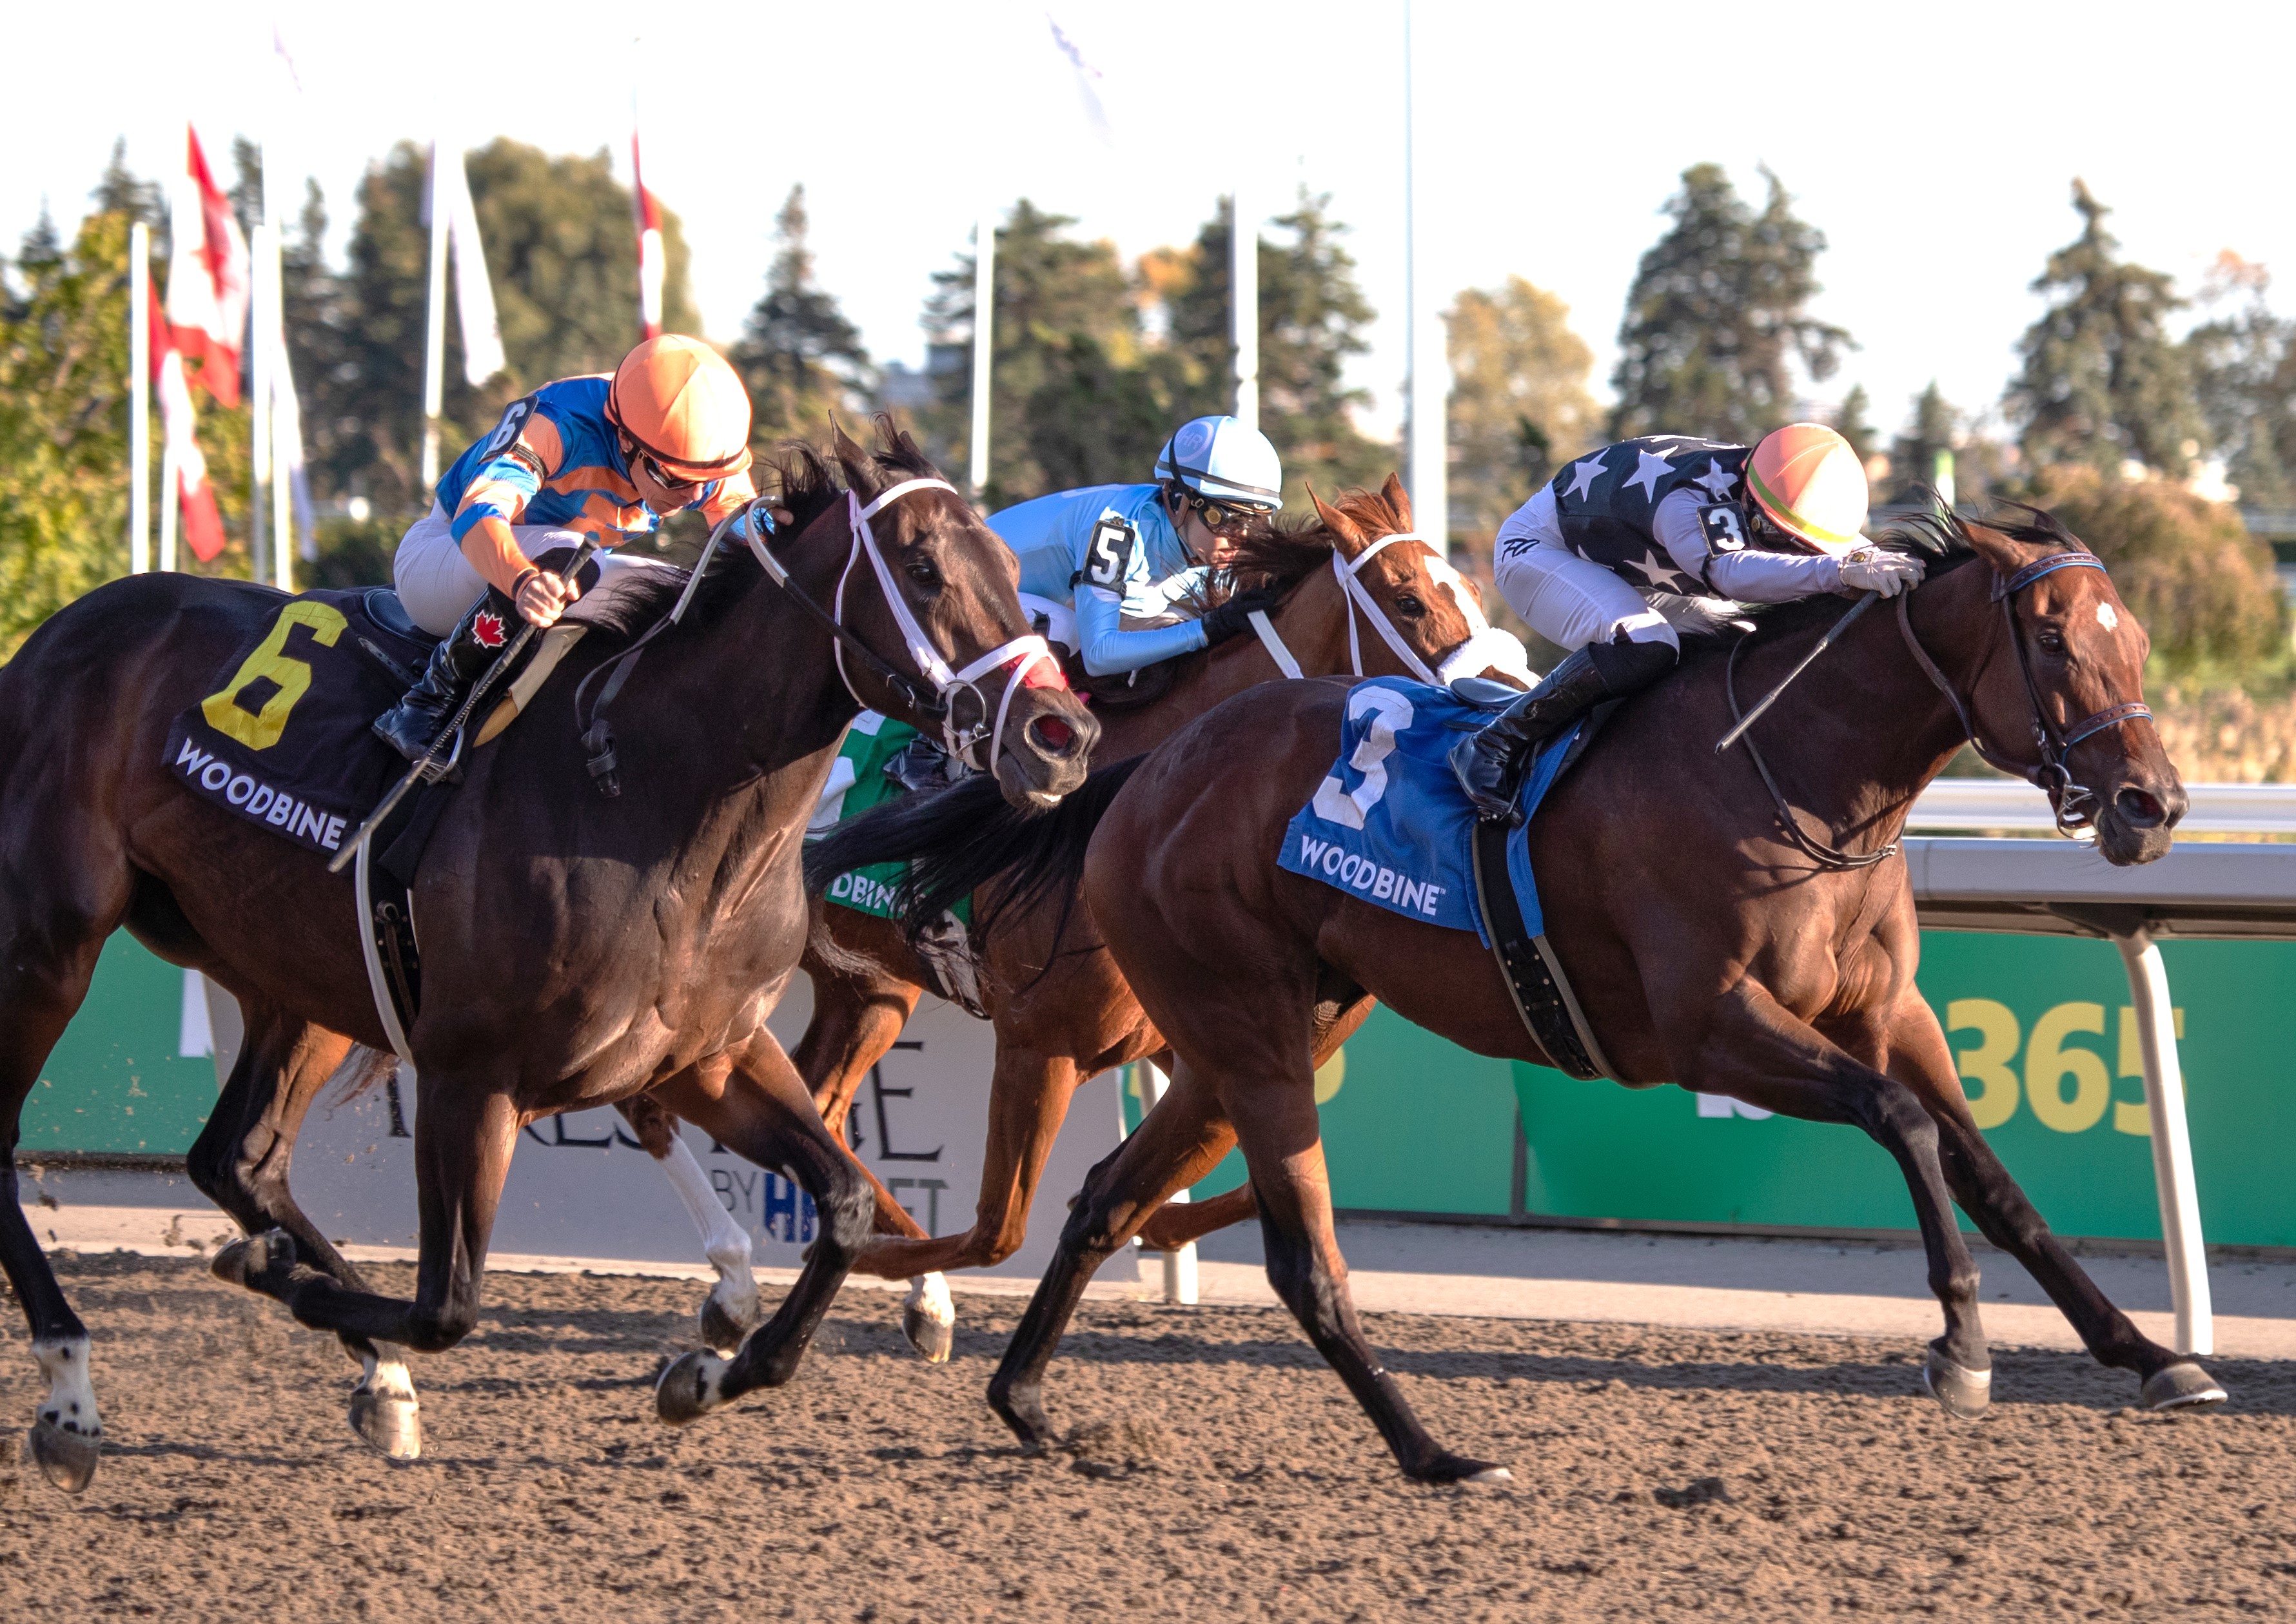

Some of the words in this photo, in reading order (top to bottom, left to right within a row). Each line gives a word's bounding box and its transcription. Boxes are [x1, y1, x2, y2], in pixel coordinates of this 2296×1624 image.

[488, 402, 527, 451] 6
[1090, 526, 1126, 585] 5
[1708, 507, 1745, 551] 3
[201, 600, 348, 751] 6
[1313, 685, 1414, 830] 3
[175, 738, 347, 850] WOODBINE
[831, 872, 908, 914] DBIN
[1301, 835, 1440, 915] WOODBINE
[711, 1169, 757, 1213] BY
